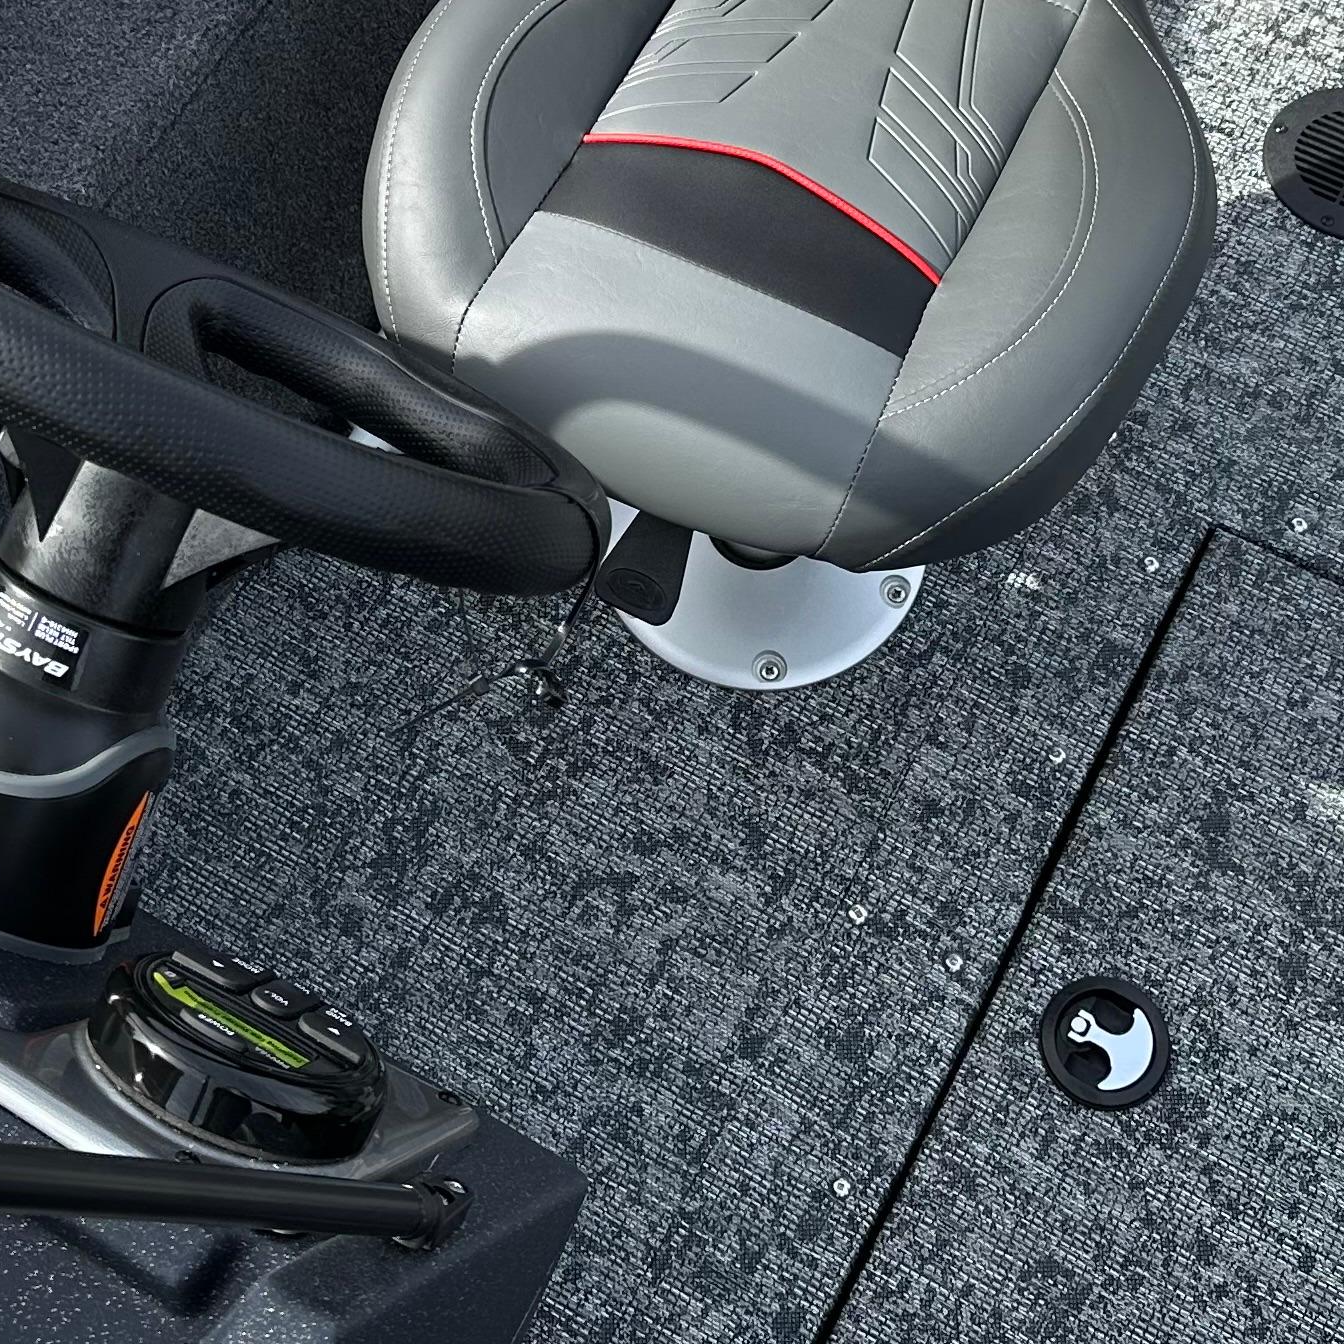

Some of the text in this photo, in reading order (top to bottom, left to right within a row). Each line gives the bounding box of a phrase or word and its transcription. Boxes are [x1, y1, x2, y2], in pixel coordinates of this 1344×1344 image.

[54, 639, 79, 654] SPORT
[102, 825, 135, 897] WARNING
[231, 954, 260, 974] MODE
[197, 1010, 235, 1036] POWER
[324, 1007, 352, 1026] BAND
